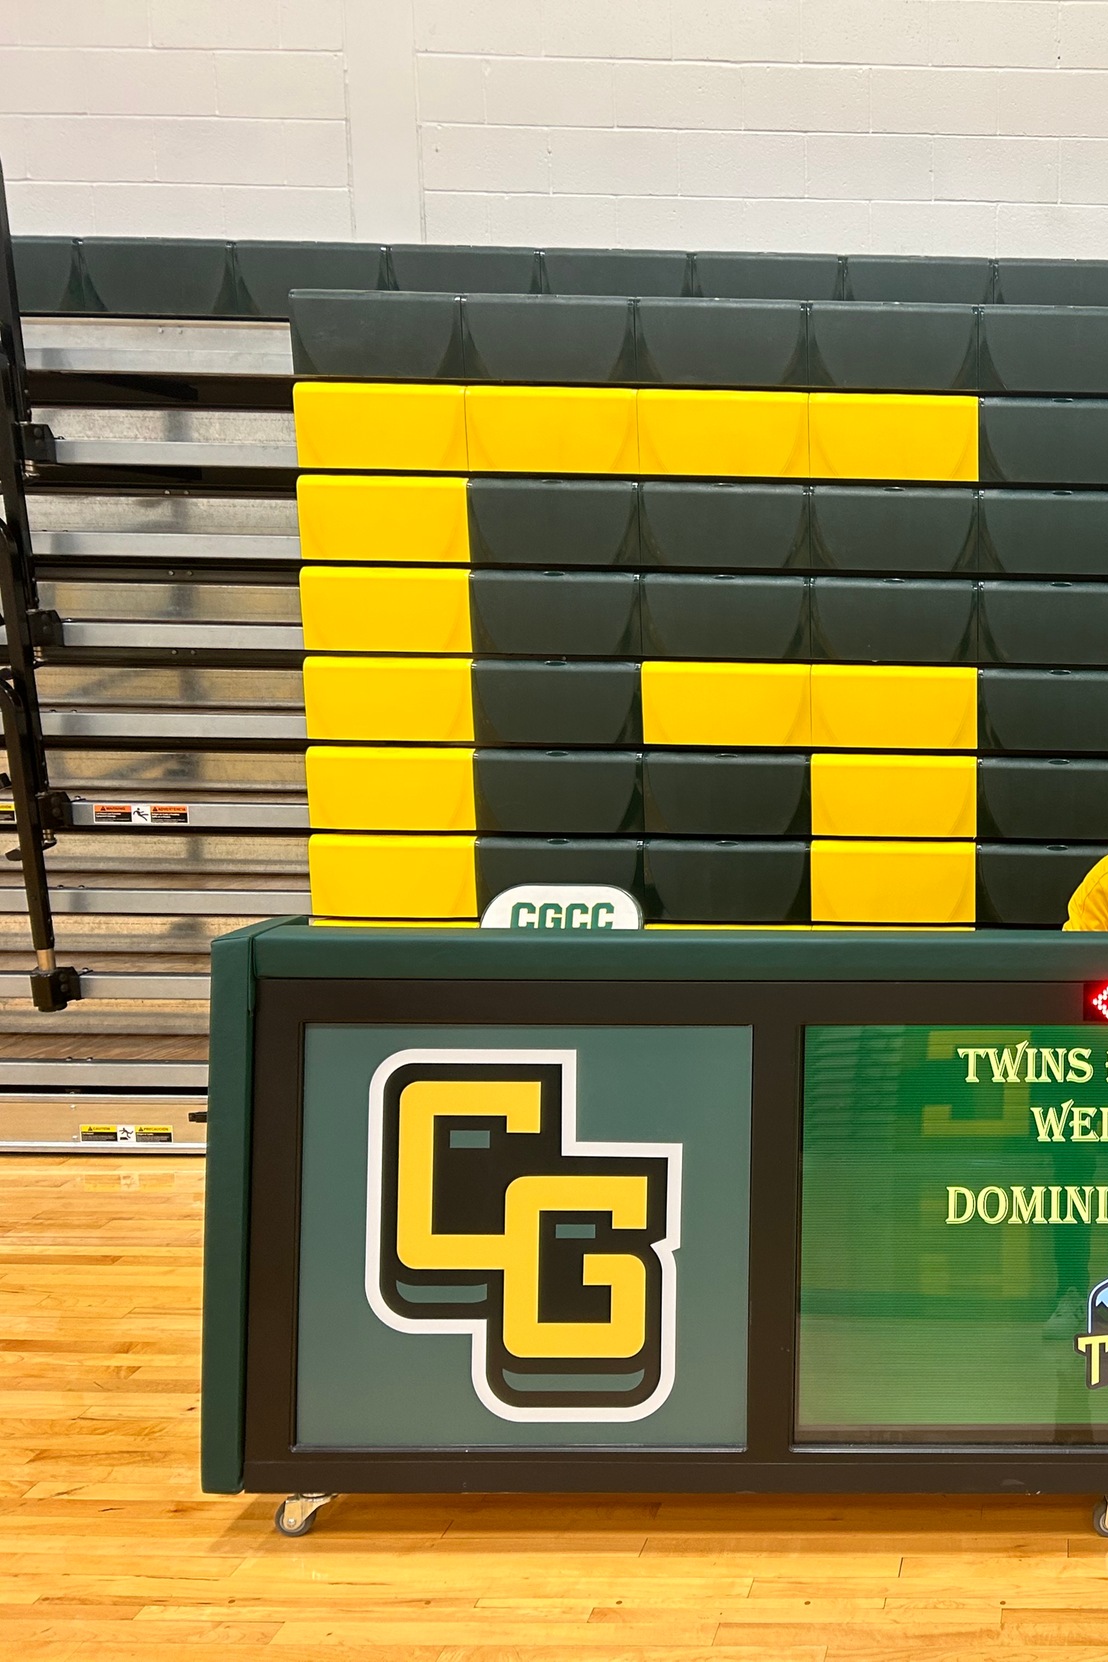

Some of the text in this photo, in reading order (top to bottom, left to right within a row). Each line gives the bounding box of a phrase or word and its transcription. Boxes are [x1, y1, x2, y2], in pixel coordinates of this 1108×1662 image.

[510, 902, 614, 929] CGCC
[957, 1040, 1093, 1083] TWINS
[396, 1080, 649, 1359] CG
